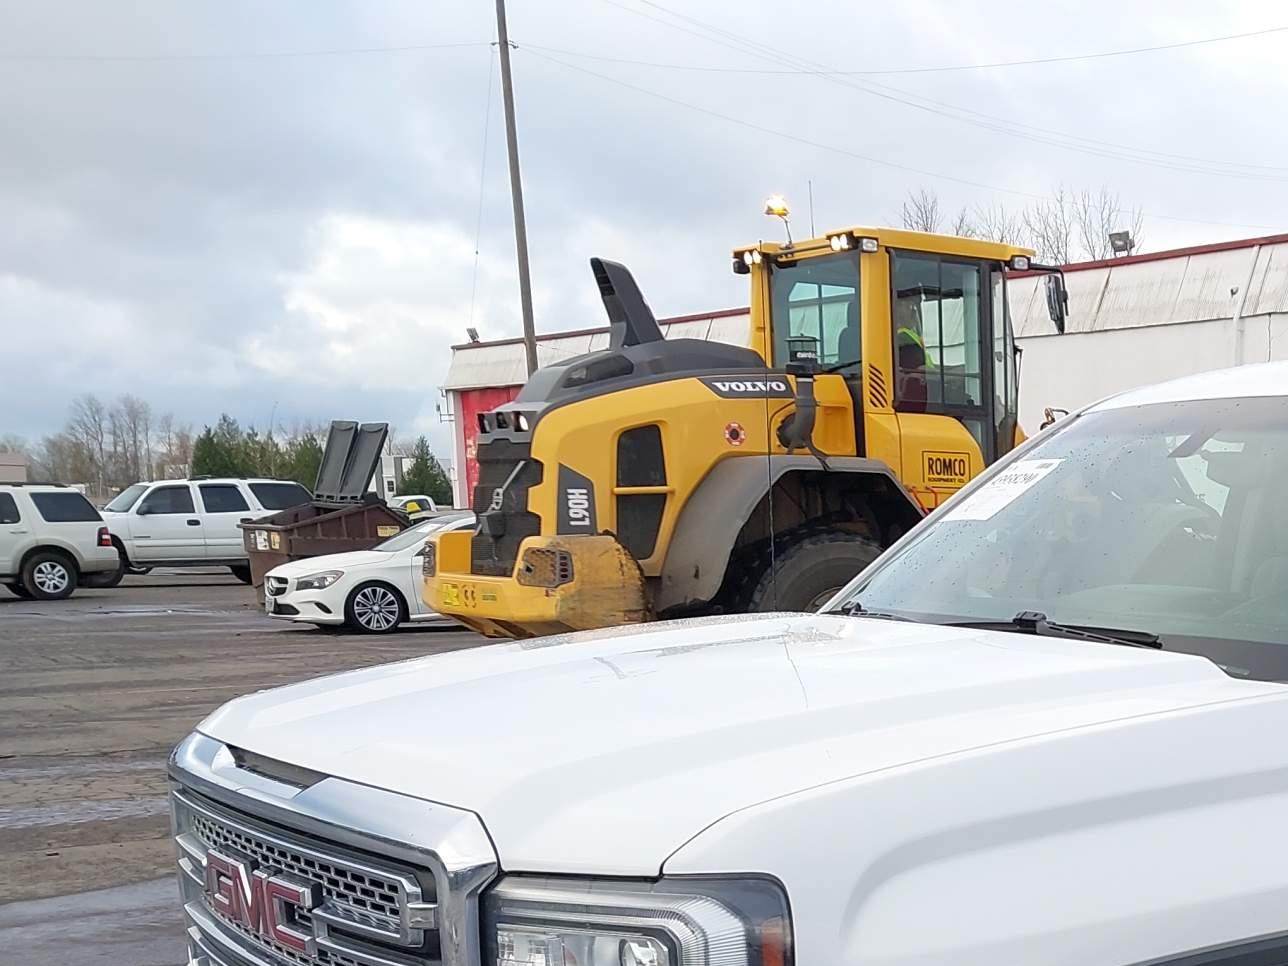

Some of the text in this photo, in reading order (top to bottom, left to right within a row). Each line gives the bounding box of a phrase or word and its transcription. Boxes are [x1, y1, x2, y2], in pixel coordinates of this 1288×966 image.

[711, 381, 786, 392] VOLVO
[928, 457, 965, 477] ROMCO
[567, 488, 590, 526] L90H
[207, 850, 315, 958] GMC
